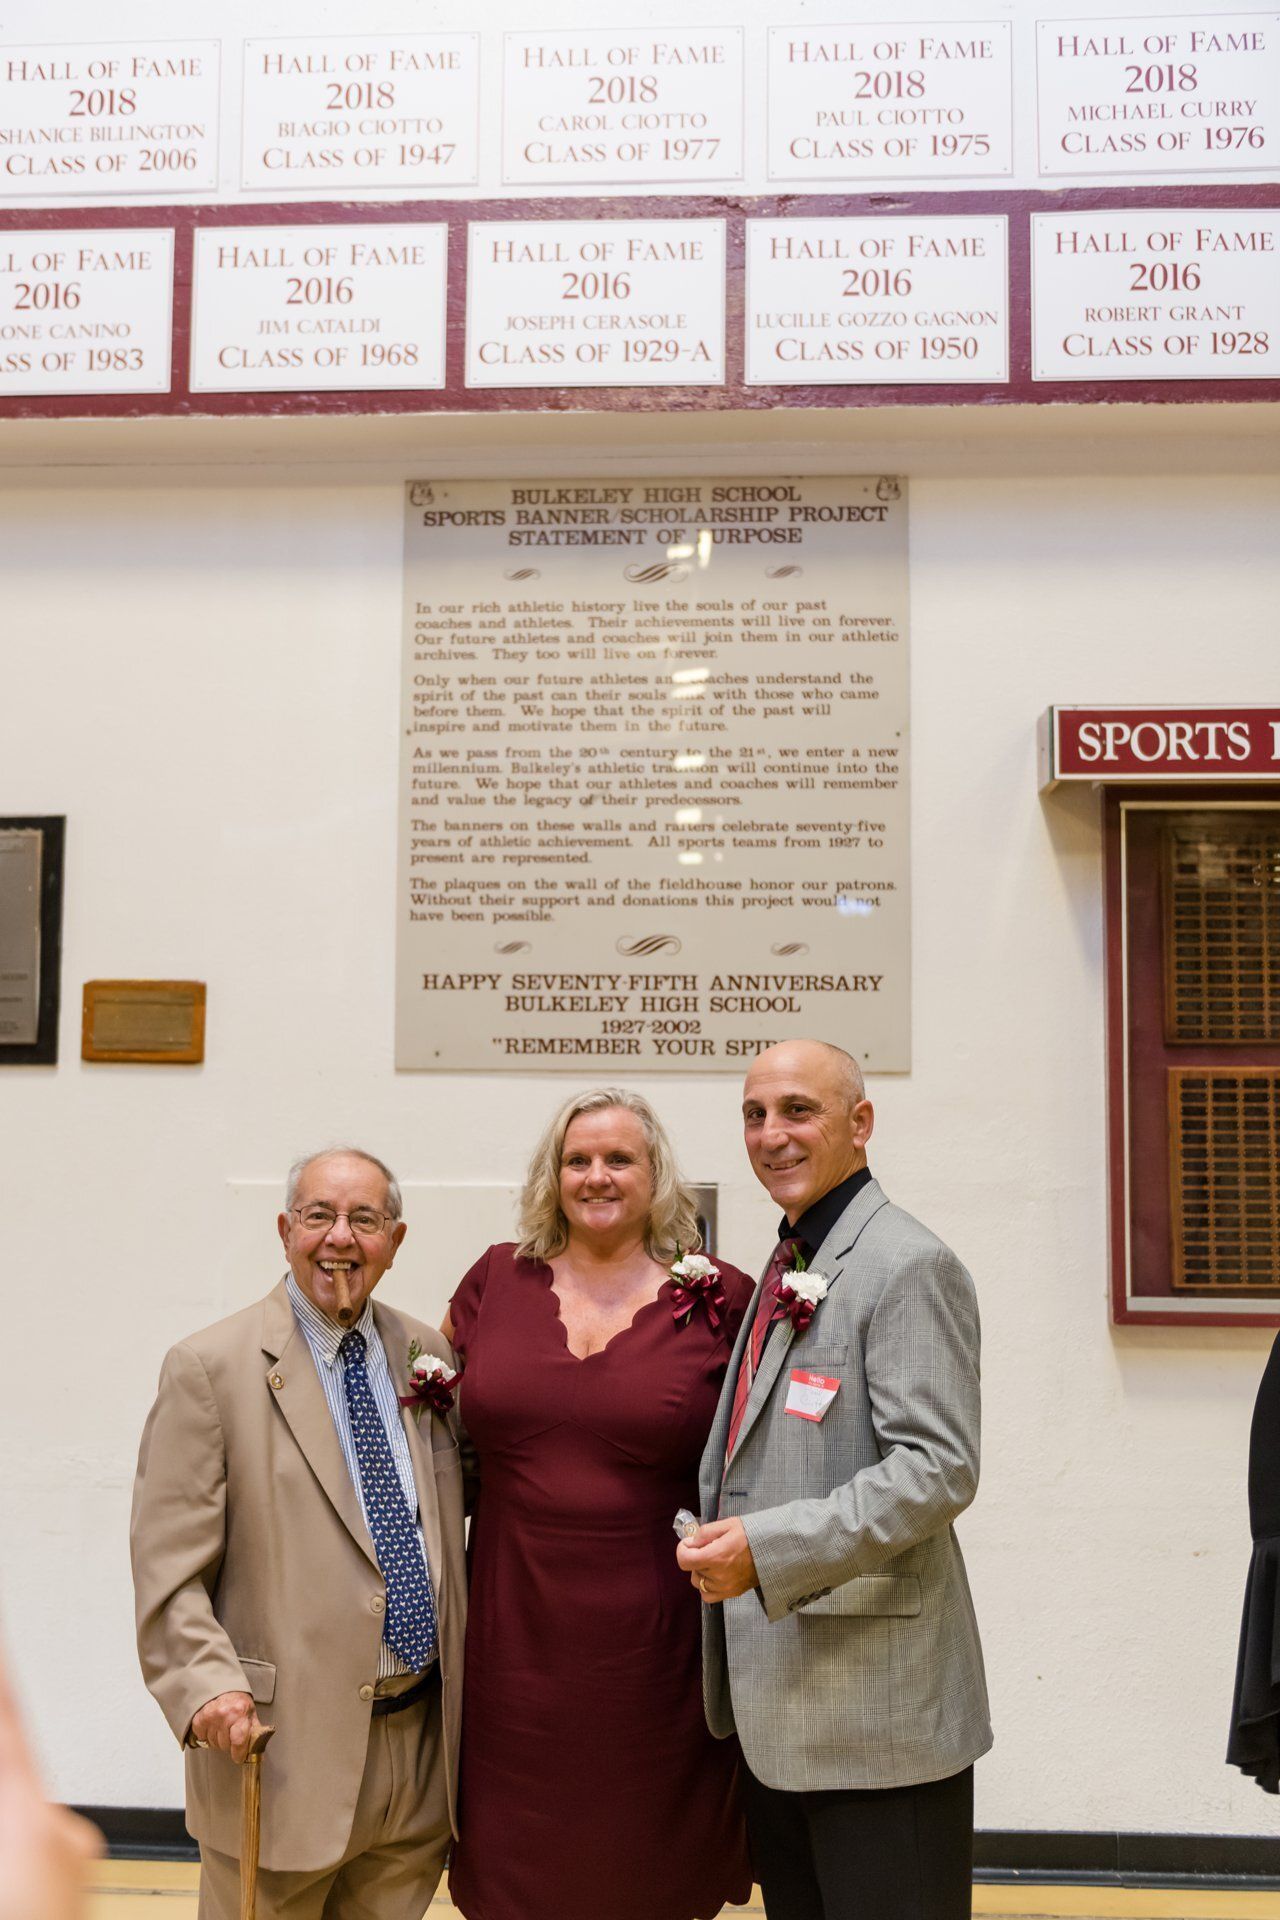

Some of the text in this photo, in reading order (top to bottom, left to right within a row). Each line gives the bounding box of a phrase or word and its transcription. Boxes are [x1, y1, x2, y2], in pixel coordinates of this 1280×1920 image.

[789, 39, 992, 62] HALL OF FAME
[1058, 32, 1265, 56] HALL OF FAME
[264, 51, 460, 74] HALL OF FAME
[524, 44, 724, 68] HALL OF FAME
[8, 57, 200, 81] HALL OF FAME
[1126, 64, 1197, 93] 2018
[327, 83, 394, 110] 2018
[589, 76, 657, 103] 2018
[855, 71, 925, 99] 2018
[69, 89, 136, 116] 2018
[1069, 101, 1256, 121] MICHAEL CURRY
[279, 119, 443, 138] BIAGIO CIOTTO
[538, 113, 707, 131] CAROL CIOTTO
[816, 108, 964, 127] PAUL CIOTTO
[91, 124, 204, 142] BILLINGTON
[1061, 127, 1264, 153] CLASS OF 1976
[262, 144, 456, 169] CLASS OF 1947
[524, 139, 720, 163] CLASS OF 1977
[790, 134, 990, 158] CLASS OF 1975
[6, 149, 196, 175] CLASS OF 2006
[493, 239, 703, 263] HALL OF FAME
[771, 236, 985, 259] HALL OF FAME
[1056, 229, 1273, 254] HALL OF FAME
[32, 253, 65, 271] OF
[78, 250, 150, 271] FAME
[218, 244, 424, 268] HALL OF FAME
[562, 272, 630, 299] 2016
[843, 269, 911, 296] 2016
[1130, 263, 1200, 291] 2016
[15, 283, 80, 310] 2016
[286, 277, 353, 304] 2016
[506, 314, 687, 330] JOSEPH CERASOLE
[757, 311, 998, 328] LUCILLE GOZZO GAGNON
[1086, 306, 1245, 322] ROBERT GRANT
[49, 324, 131, 339] CANINO
[258, 318, 380, 334] JIM CATALDI
[478, 340, 712, 364] CLASS OF 1929-A
[776, 337, 978, 361] CLASS OF 1950
[1063, 332, 1269, 356] CLASS OF 1928
[41, 353, 75, 371] OF
[88, 348, 143, 371] 1983
[218, 344, 418, 368] CLASS OF 1968
[512, 486, 801, 505] BULKELEY HIGH SCHOOL
[424, 505, 888, 526] SPORTS BANNER/SCHOLARSHIP PROJECT
[509, 526, 802, 546] STATEMENT OF URPOSE
[416, 599, 827, 615] In our rich athletic history live the souls of our past
[415, 618, 472, 629] coaches
[478, 617, 506, 629] and
[588, 616, 628, 628] Their
[635, 616, 735, 627] achievements
[741, 615, 770, 626] will
[779, 615, 805, 626] live
[812, 618, 831, 626] on
[1079, 722, 1250, 761] SPORTS
[411, 853, 464, 866] present
[471, 855, 495, 863] are
[410, 878, 437, 889] The
[445, 878, 501, 893] plaques
[507, 881, 526, 890] on
[534, 878, 557, 890] the
[565, 878, 597, 890] wall
[604, 878, 620, 890] of
[627, 879, 651, 890] the
[659, 878, 742, 890] fieldhouse
[750, 878, 795, 890] honor
[802, 882, 828, 890] our
[410, 910, 444, 921] have
[451, 910, 484, 921] been
[423, 974, 883, 991] HAPPY SEVENTY-FIFTH ANNIVERSARY
[506, 996, 801, 1012] BULKELEY HIGH SCHOOL
[602, 1020, 701, 1034] 1927-2002
[652, 1039, 715, 1055] YOUR
